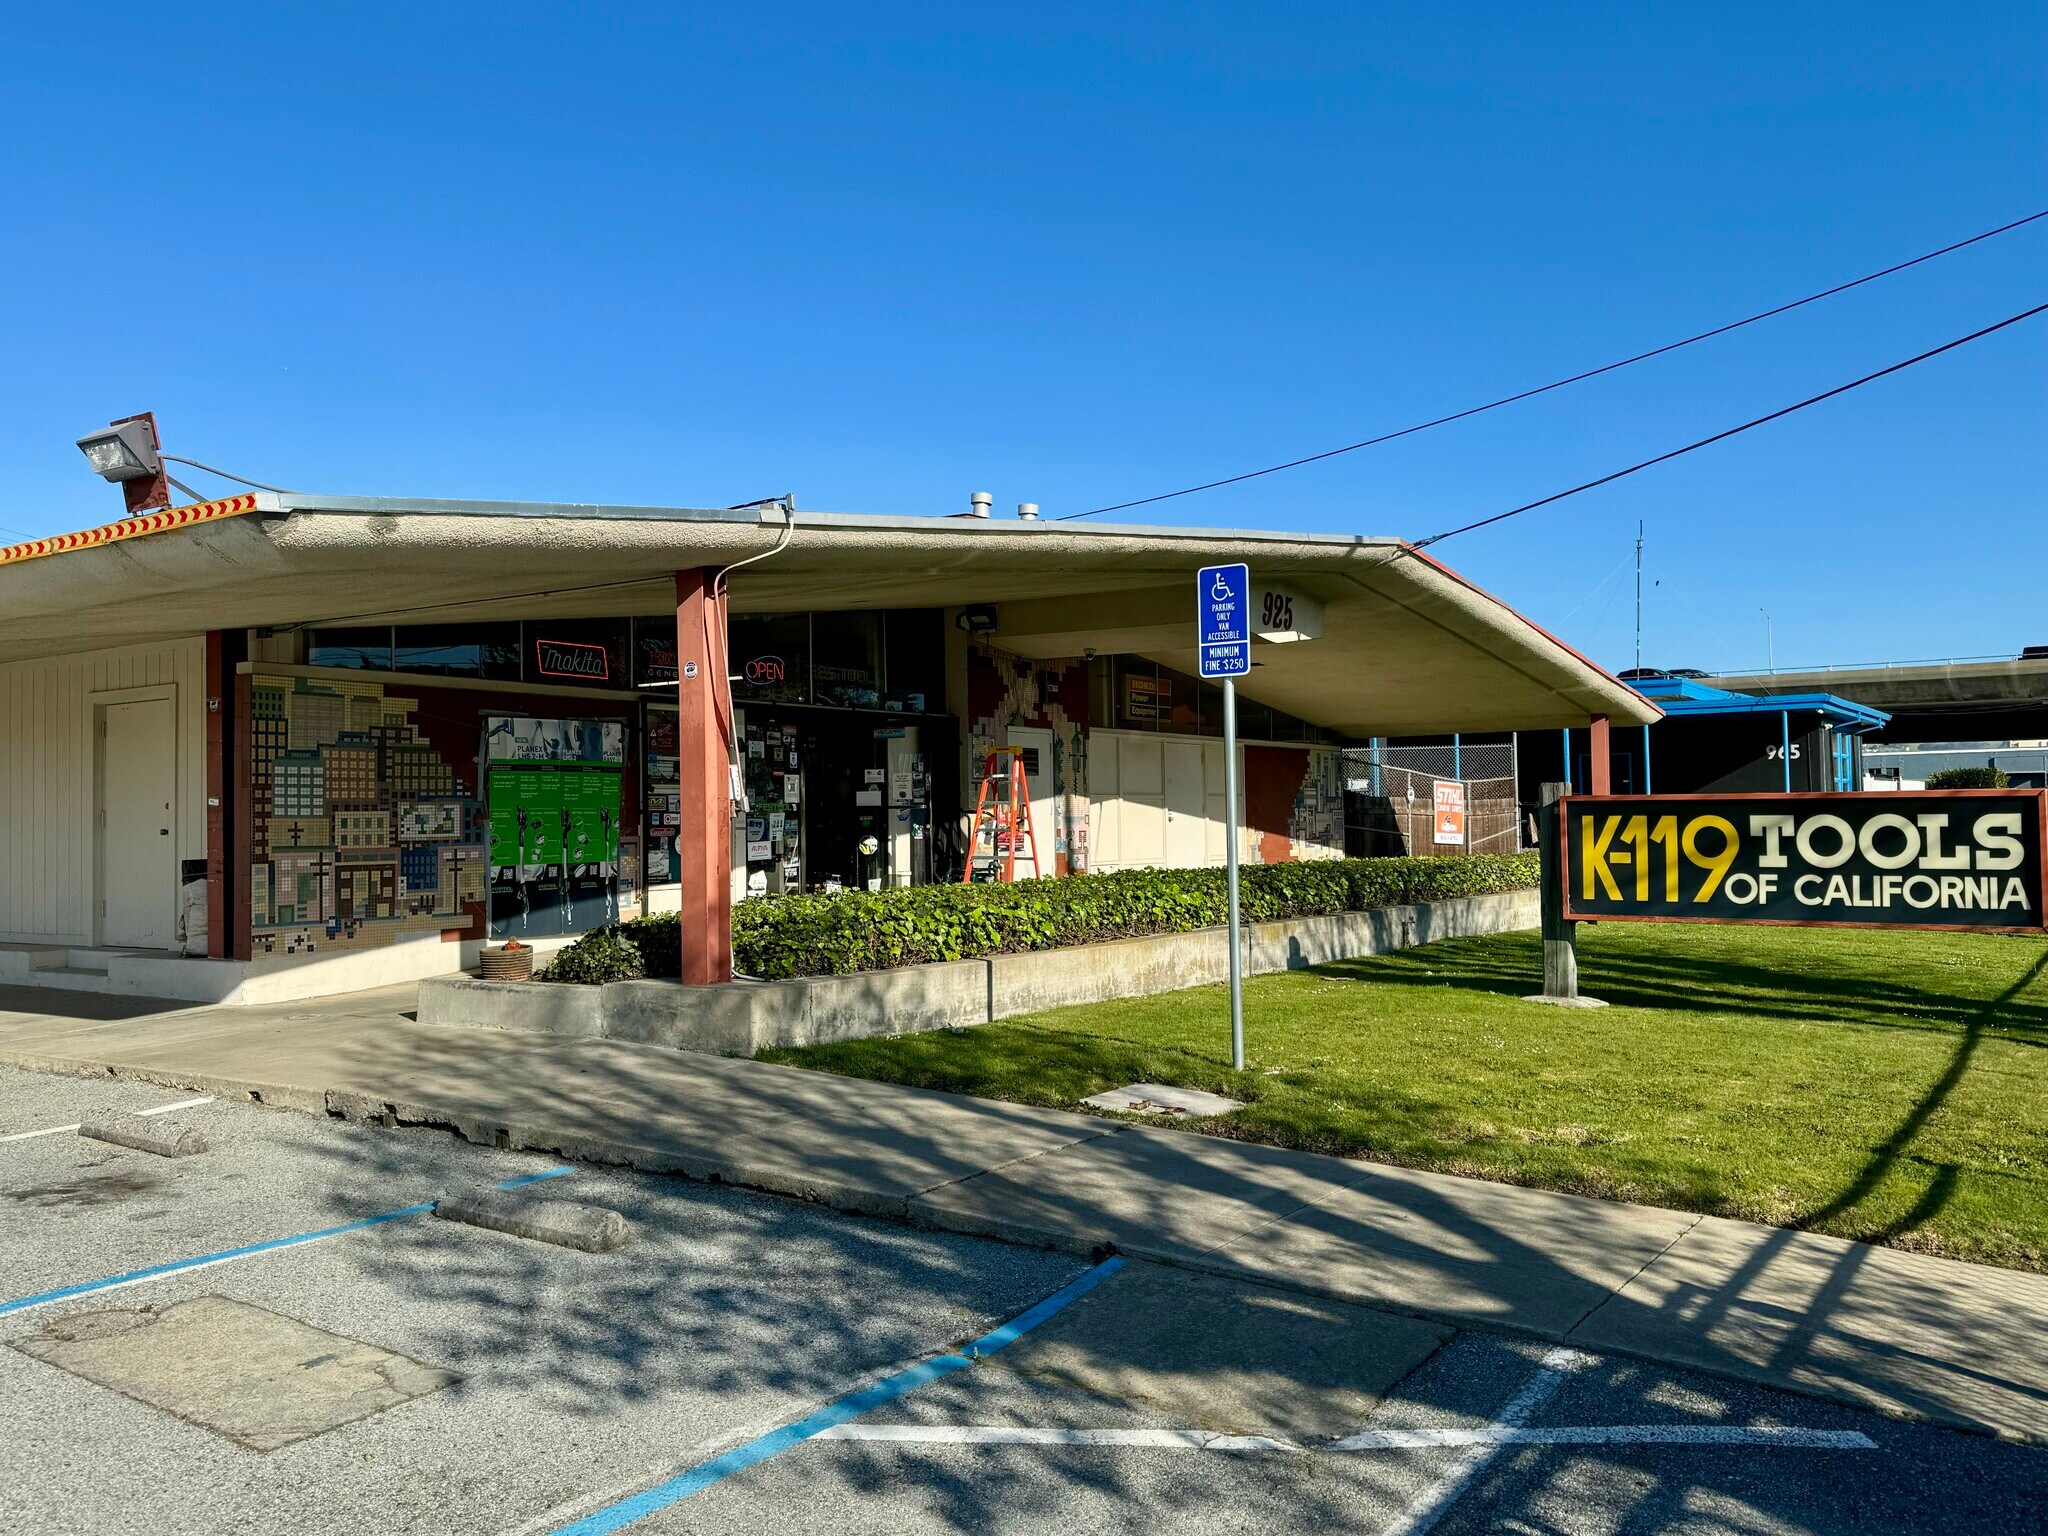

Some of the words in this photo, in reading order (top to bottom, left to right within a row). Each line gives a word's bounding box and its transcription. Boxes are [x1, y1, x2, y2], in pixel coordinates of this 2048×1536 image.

[1211, 602, 1235, 612] PARKING
[1262, 591, 1293, 630] 925
[1216, 612, 1231, 621] ONLY
[1218, 622, 1229, 631] VAN
[1207, 630, 1240, 641] ACCESSIBLE
[1209, 646, 1240, 658] MINIMUM
[745, 660, 785, 680] OPEN
[1205, 660, 1220, 671] FINE
[1222, 658, 1244, 671] $250
[1131, 692, 1149, 702] Power
[517, 745, 543, 753] PLANEX
[1766, 743, 1801, 760] 965
[1436, 786, 1463, 805] STIHL
[1581, 815, 1740, 903] K-119
[1749, 813, 2025, 871] TOOLS
[1724, 872, 1778, 904] OF
[1793, 873, 2032, 911] CALIFORNIA
